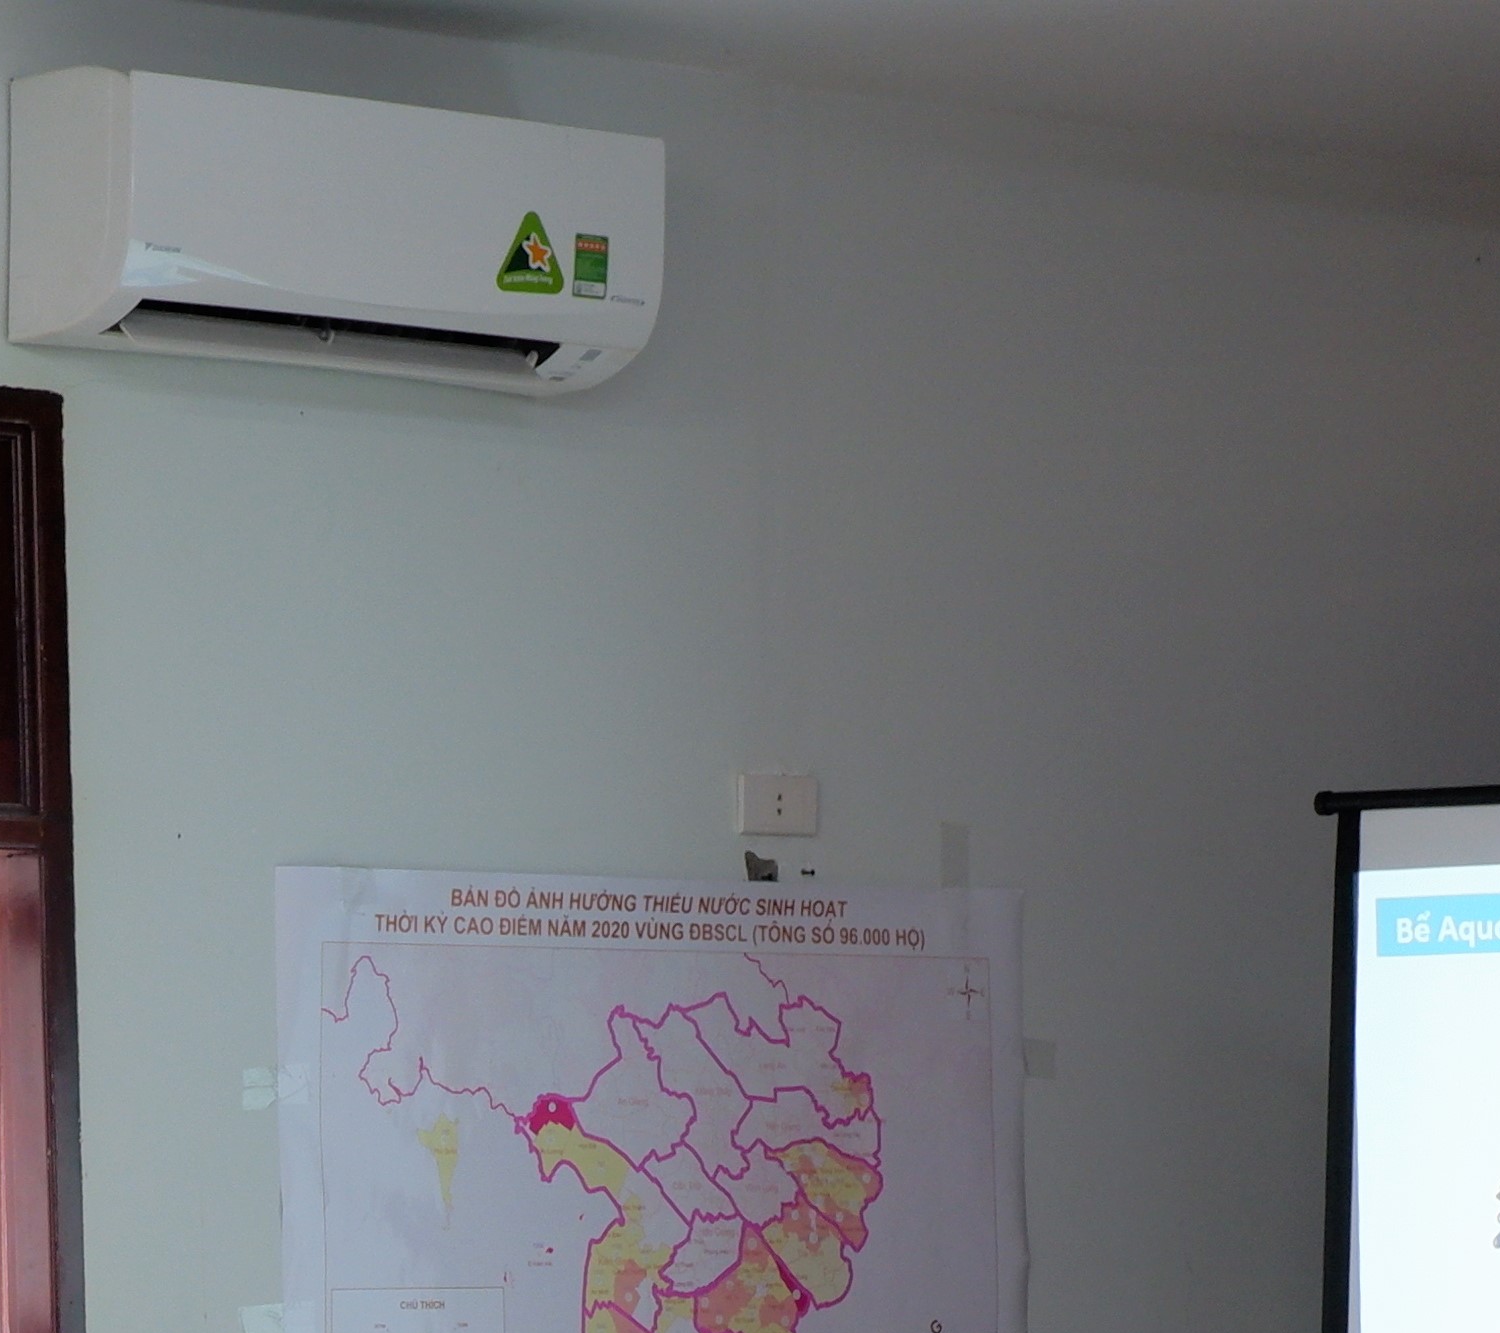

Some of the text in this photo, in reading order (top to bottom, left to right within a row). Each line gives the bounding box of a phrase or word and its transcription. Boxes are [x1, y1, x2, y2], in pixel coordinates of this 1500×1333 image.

[450, 885, 849, 919] BẢN ĐỒ ẢNH HƯỞNG THIẾU NƯỚC SINH HOẠT
[374, 909, 418, 933] THỜI
[423, 910, 449, 934] KỲ
[453, 916, 494, 936] CAO
[499, 914, 542, 937] ĐIỂM
[547, 915, 587, 938] NĂM
[590, 920, 630, 940] 2020
[635, 917, 684, 941] VÙNG
[689, 923, 748, 943] ĐBSCL
[811, 918, 835, 945] SỐ
[840, 927, 891, 947] 96.000
[895, 928, 926, 951] HỘ)
